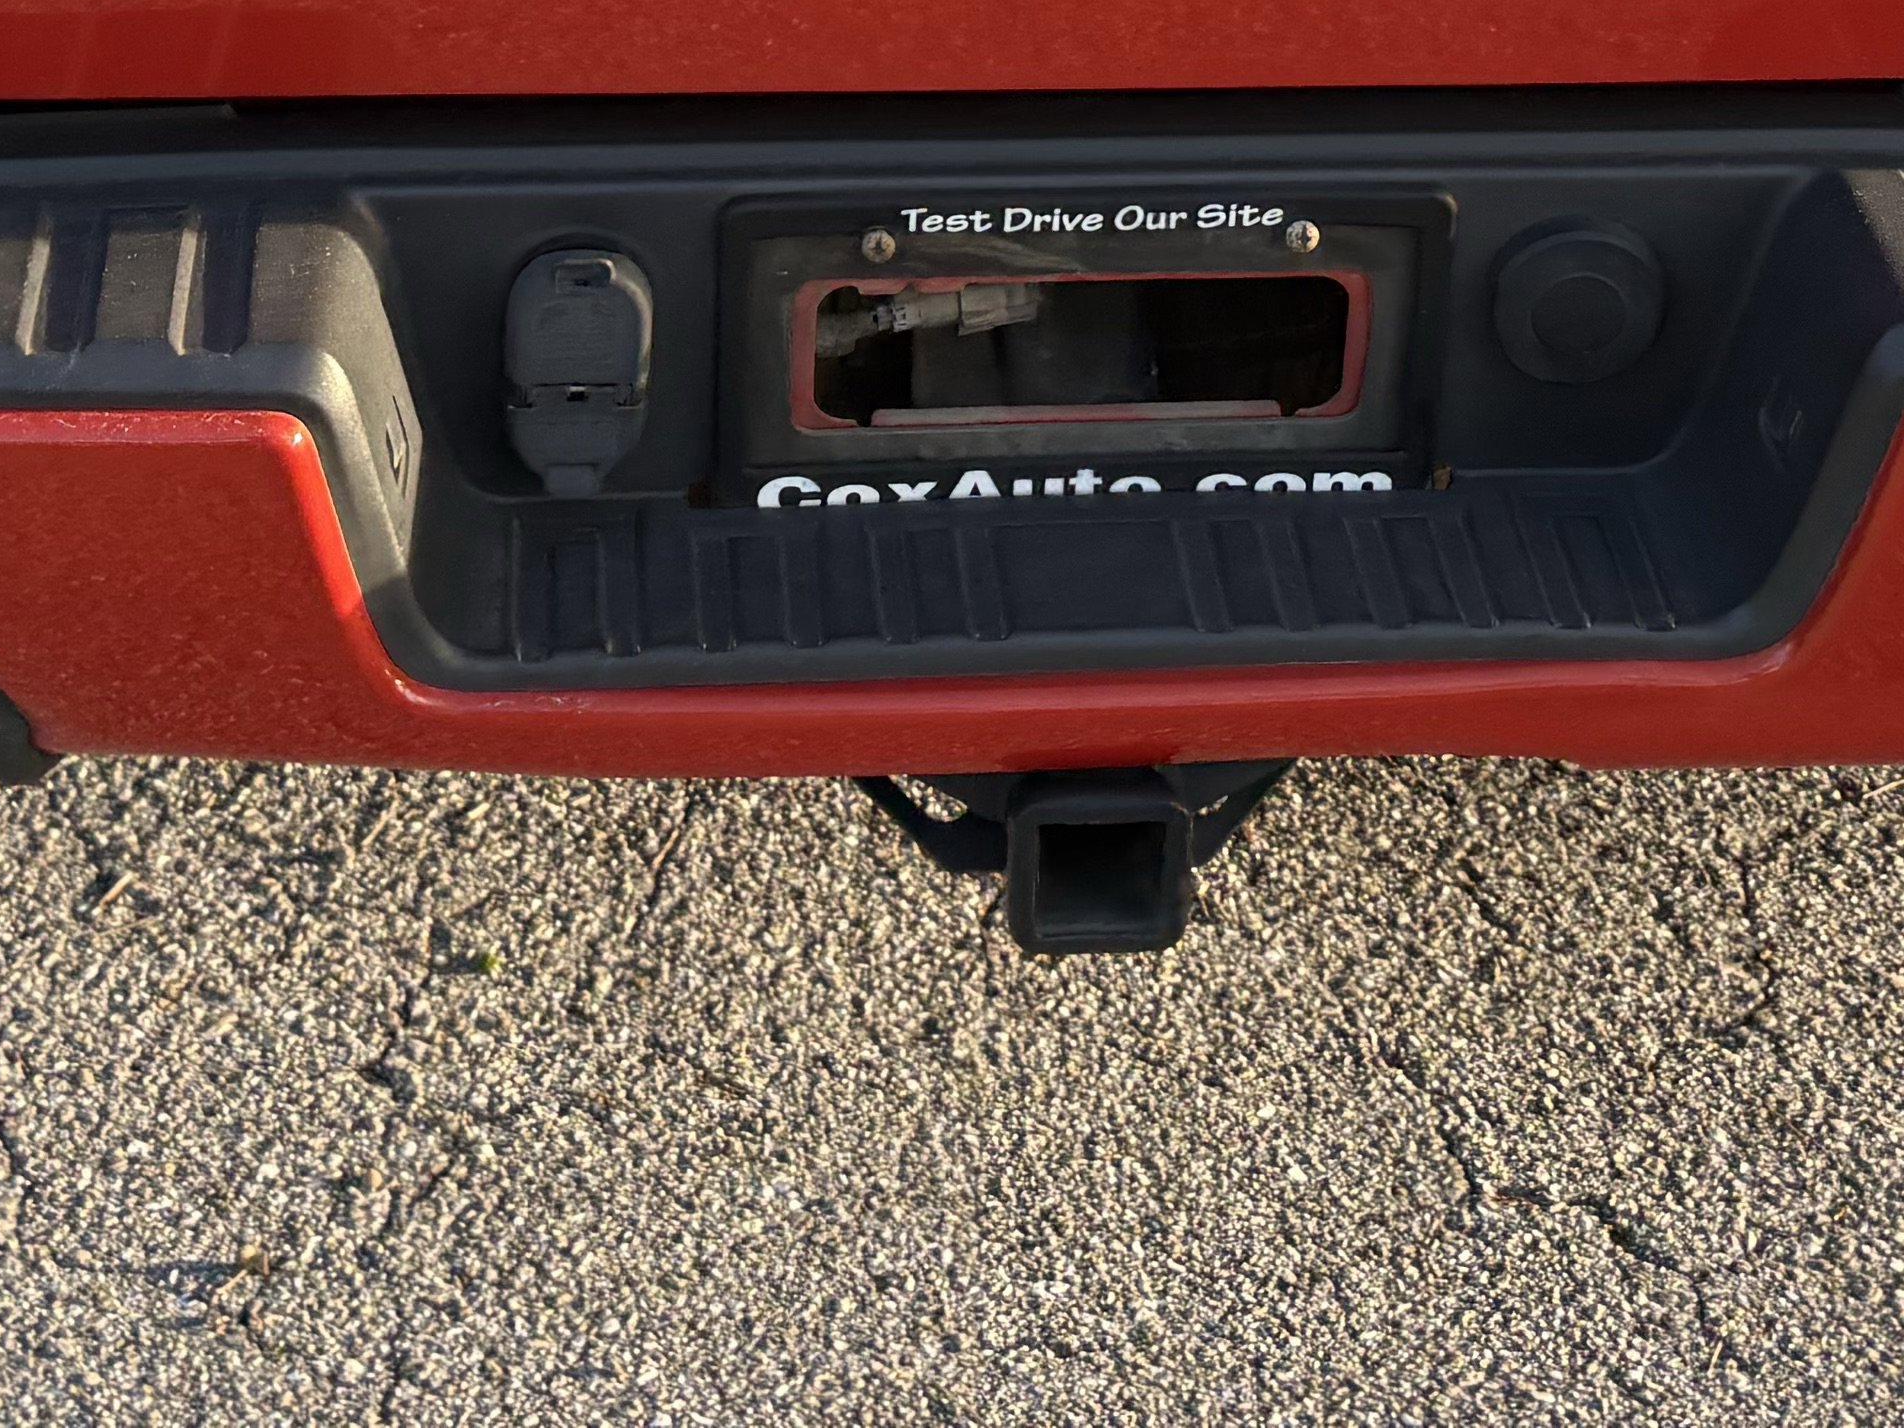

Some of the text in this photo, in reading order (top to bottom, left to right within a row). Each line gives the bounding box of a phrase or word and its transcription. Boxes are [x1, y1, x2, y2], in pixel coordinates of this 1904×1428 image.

[900, 203, 1285, 233] Test Drive Our Site
[756, 468, 1394, 509] CoxAutocom
